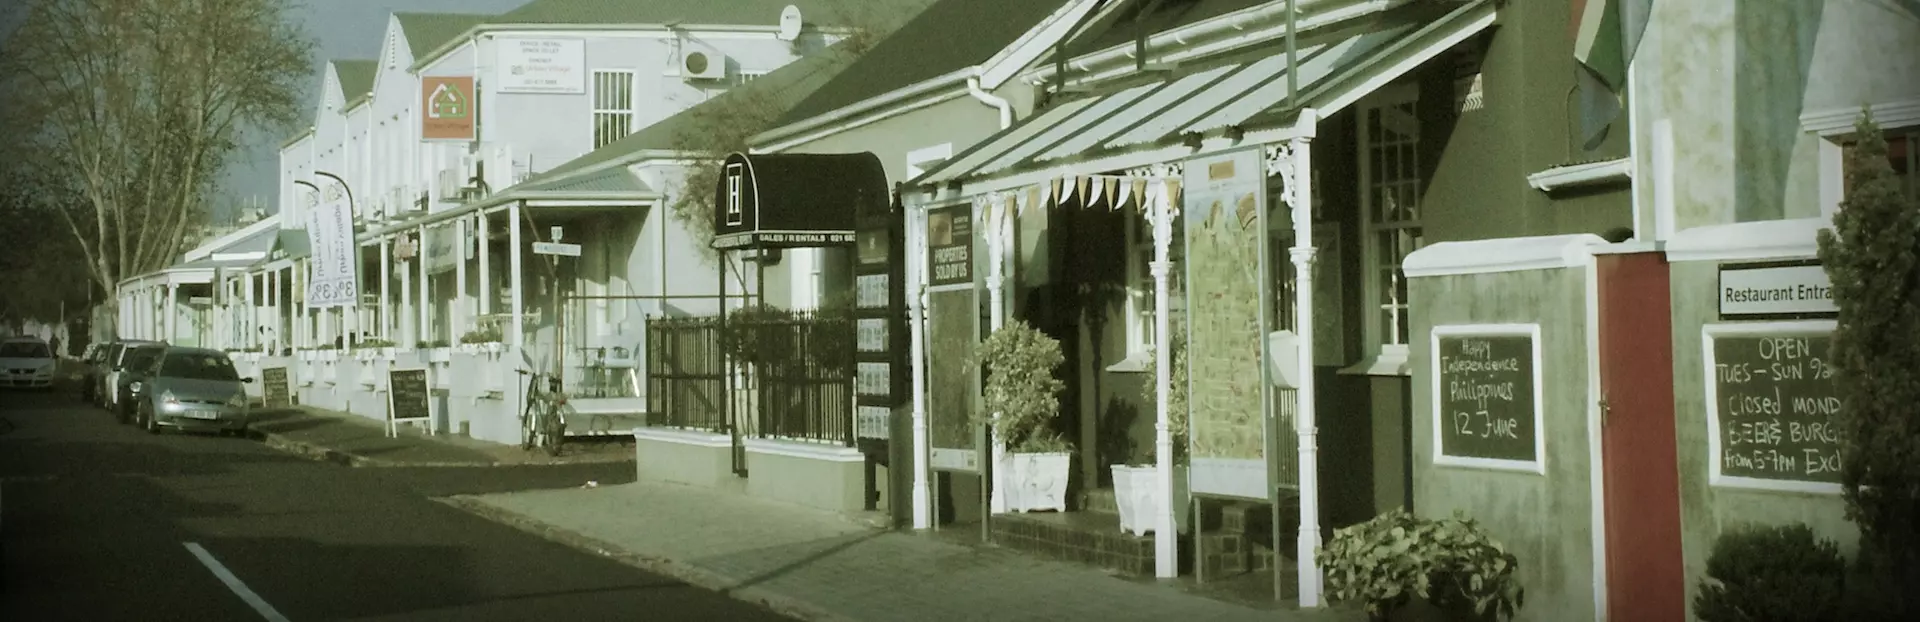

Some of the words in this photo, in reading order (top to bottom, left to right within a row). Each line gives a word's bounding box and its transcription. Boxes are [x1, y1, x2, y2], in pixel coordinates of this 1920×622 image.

[729, 176, 740, 214] H
[759, 234, 784, 242] SALES
[934, 245, 968, 264] PROPERTIES
[935, 263, 951, 280] SOLD
[958, 261, 968, 278] US
[1726, 286, 1793, 302] Restaurant
[1462, 338, 1491, 360] Happy
[1759, 336, 1810, 361] OPEN
[1441, 356, 1519, 376] Independence
[1716, 362, 1751, 383] TUES
[1771, 362, 1802, 381] SUN
[1450, 374, 1513, 410] Philippines
[1454, 410, 1473, 435] 12
[1476, 410, 1518, 439] June
